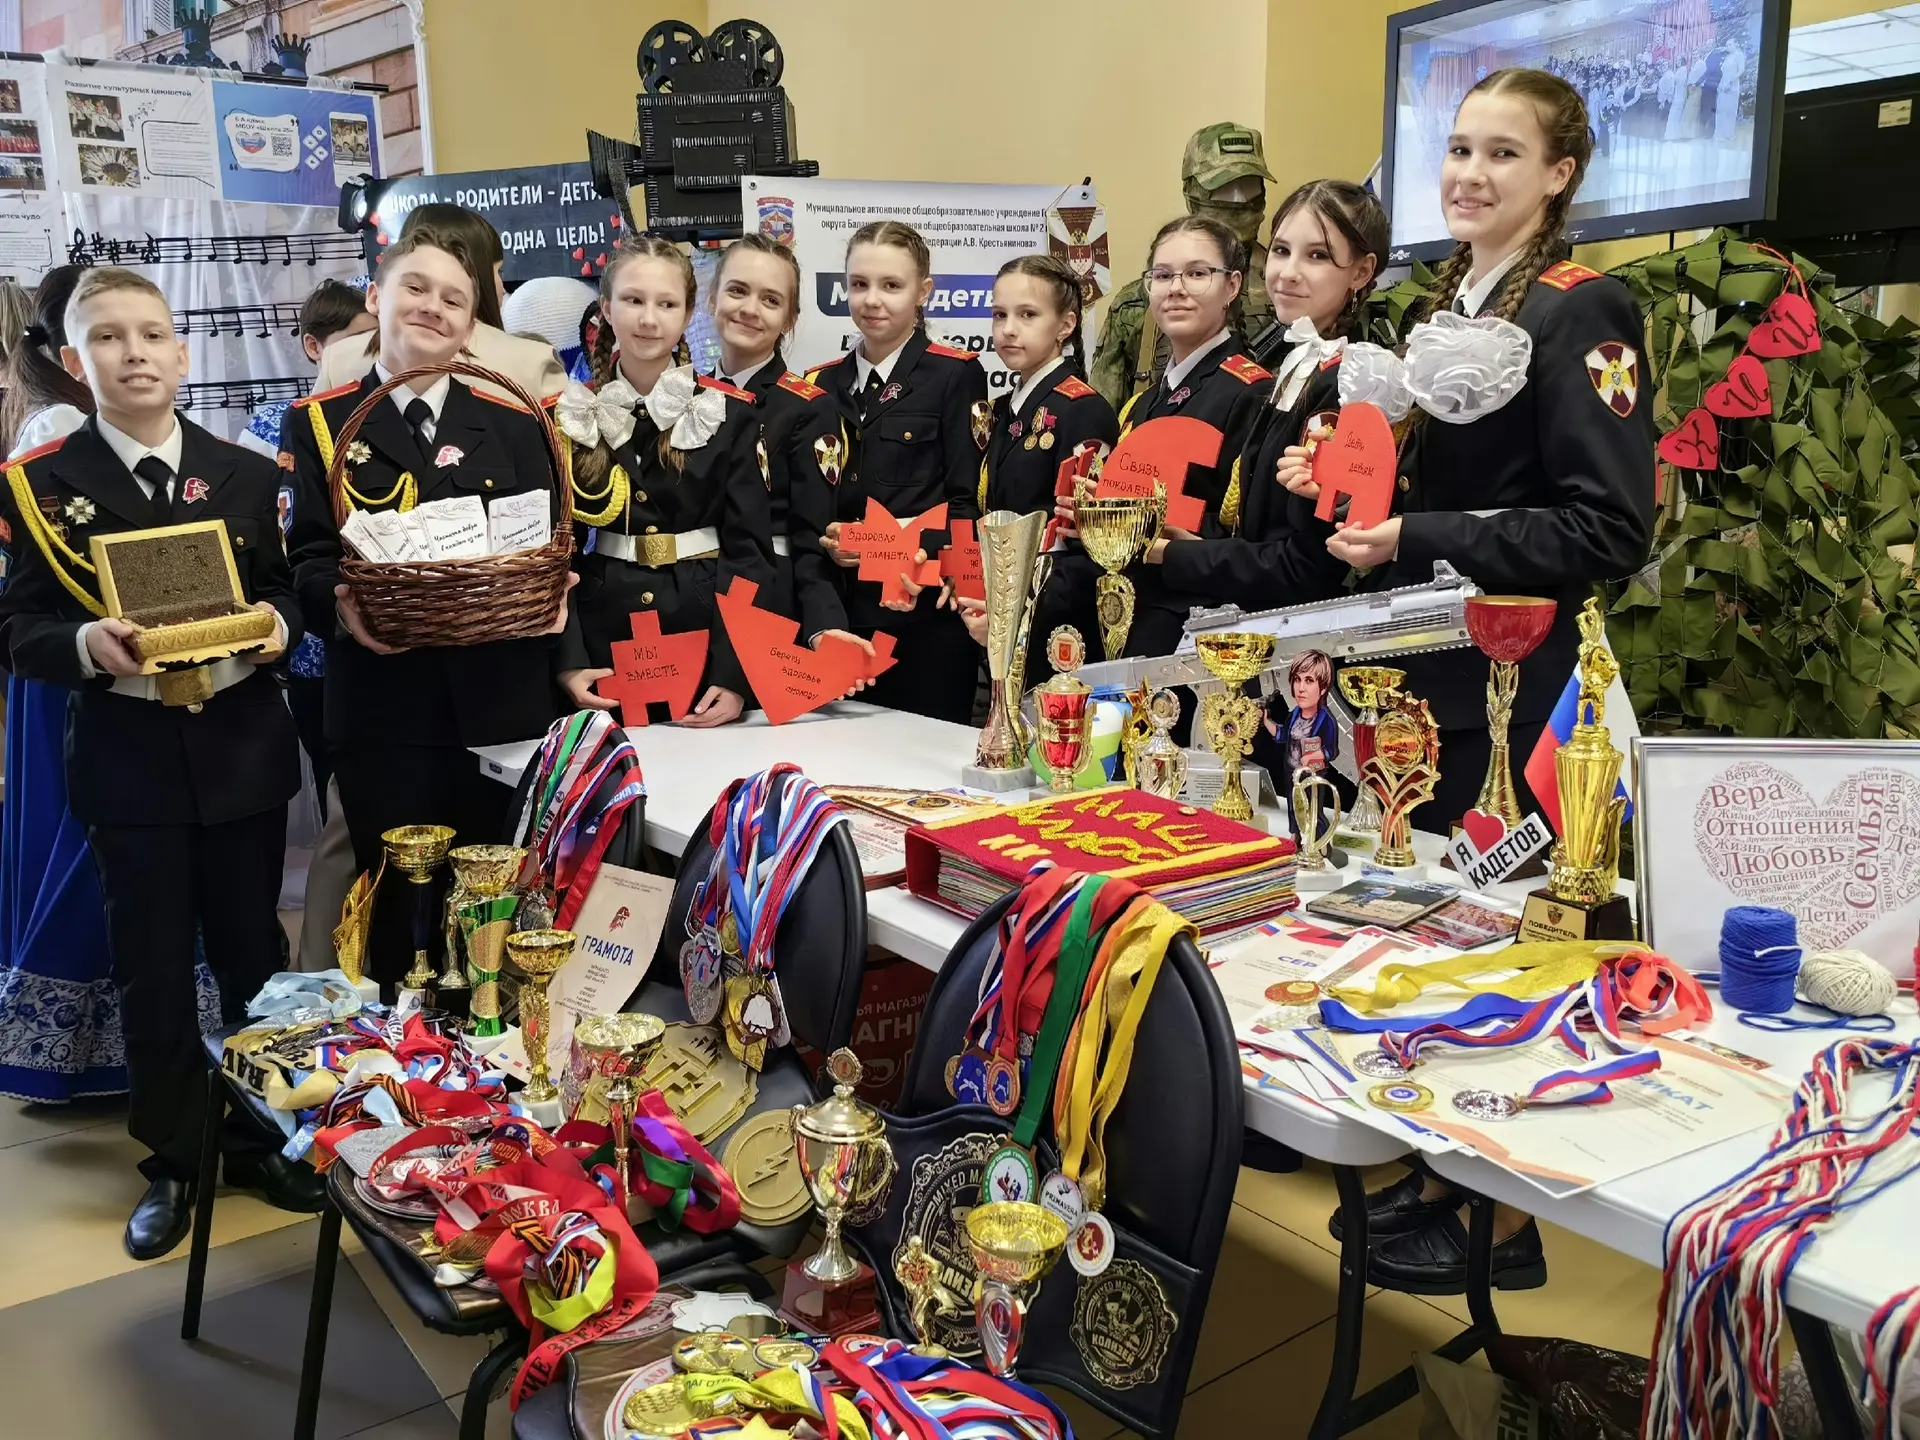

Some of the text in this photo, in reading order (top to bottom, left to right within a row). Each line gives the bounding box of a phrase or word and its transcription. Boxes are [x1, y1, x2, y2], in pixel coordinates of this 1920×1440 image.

[65, 80, 192, 96] Развитие культурных ценностей
[457, 184, 543, 211] РОДИТЕЛИ
[806, 202, 866, 214] Муниципальное
[867, 206, 910, 214] автономное
[912, 206, 994, 221] общеобразовательное
[996, 209, 1040, 219] учреждение
[821, 221, 846, 230] округа
[923, 221, 1004, 234] общеобразовательная
[501, 222, 605, 254] ОДНА ЦЕЛЬ!
[963, 238, 977, 247] А.В.
[979, 238, 1037, 249] Крестьянинова»
[1119, 453, 1160, 478] Связь
[633, 646, 658, 661] МЫ
[625, 664, 679, 682] ВМЕСТЕ
[781, 665, 822, 684] здоровье
[1725, 770, 1758, 782] Вера
[1858, 771, 1888, 782] Дети
[1708, 783, 1784, 810] Вера
[1884, 775, 1905, 815] Вера
[1772, 807, 1850, 820] Дружелюбие
[1706, 818, 1855, 836] Отношения
[1456, 842, 1473, 866] Я
[1715, 838, 1765, 853] Жизнь
[1843, 784, 1884, 909] Семья
[1468, 822, 1542, 890] КАДЕТОВ
[1720, 845, 1844, 877] Любовь
[1732, 870, 1817, 888] Отношения
[1880, 858, 1893, 908] Любовь
[1779, 869, 1843, 911] ружелюбие
[1849, 889, 1872, 898] Вера
[1800, 907, 1846, 924] Дети
[1851, 910, 1876, 919] Дети
[1529, 920, 1578, 939] ПОБЕДИТЕЛЬ
[582, 935, 634, 966] ГРАМОТА
[1278, 956, 1318, 968] СЕР
[876, 994, 928, 1013] МАГАЗИ
[933, 1171, 965, 1206] MIXED
[1045, 1191, 1078, 1217] PRIMAVERA
